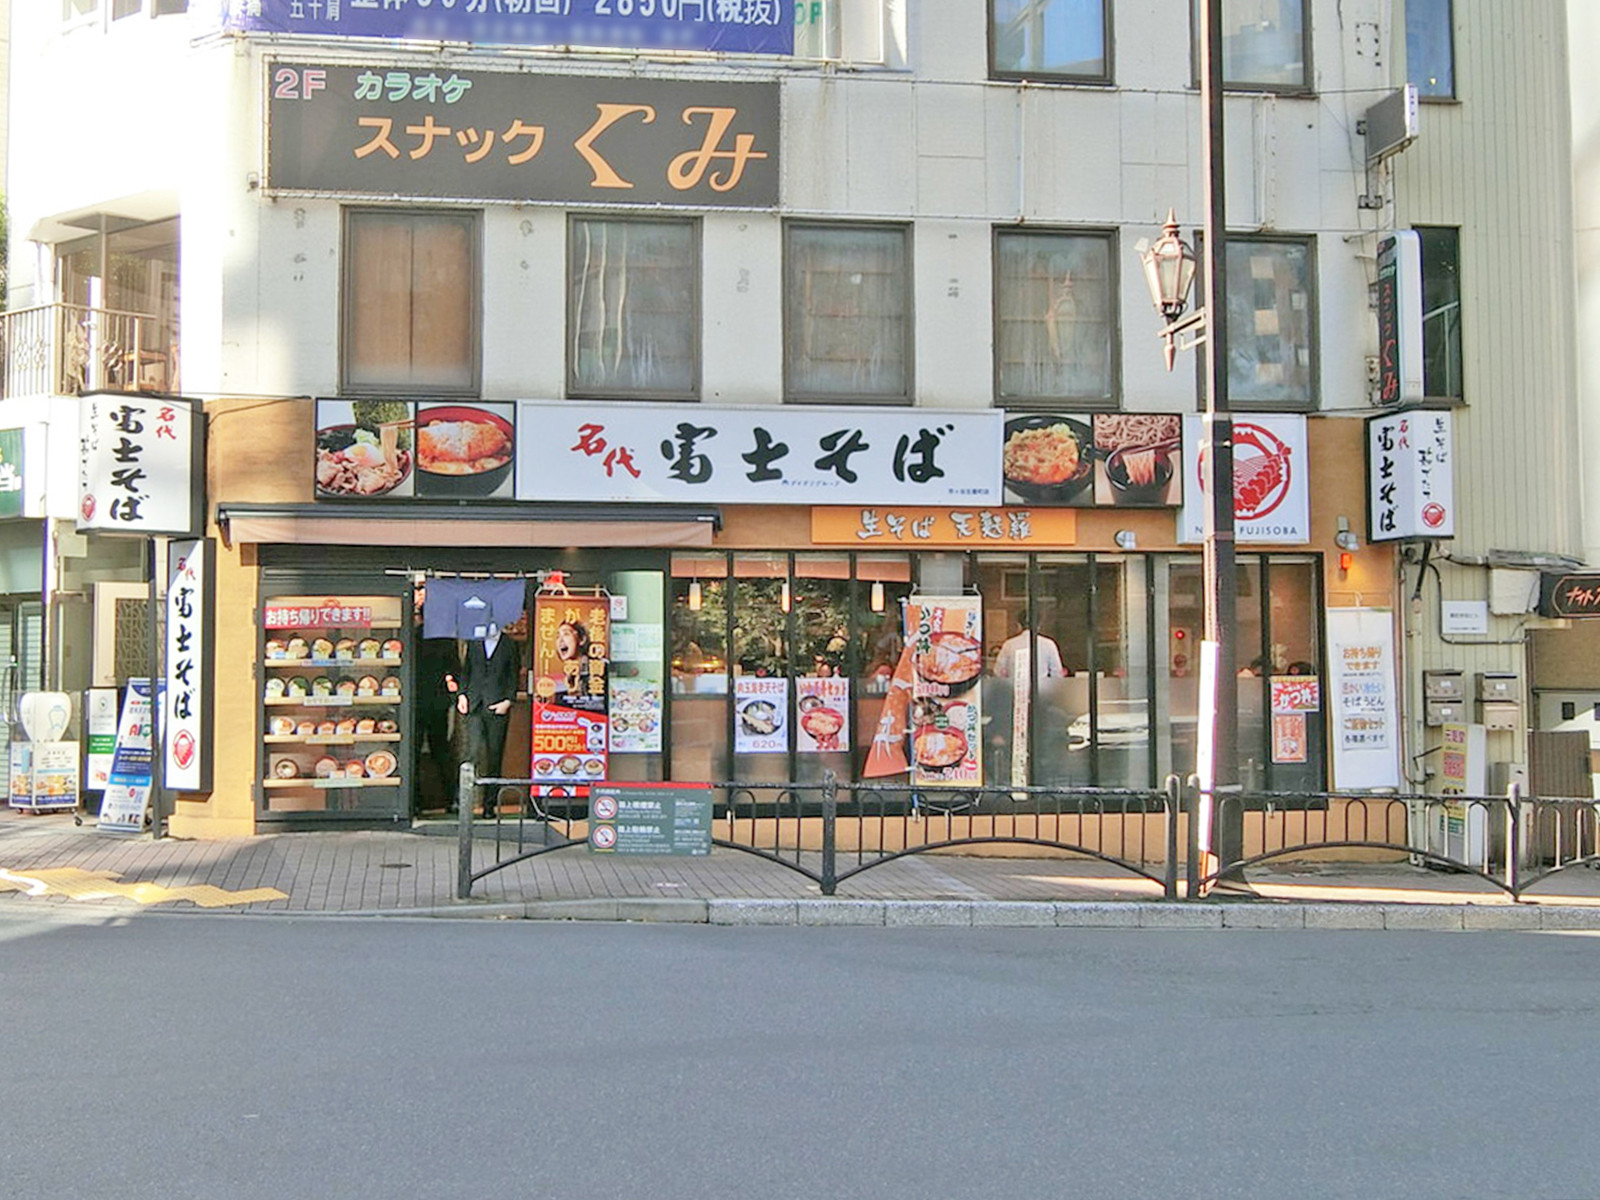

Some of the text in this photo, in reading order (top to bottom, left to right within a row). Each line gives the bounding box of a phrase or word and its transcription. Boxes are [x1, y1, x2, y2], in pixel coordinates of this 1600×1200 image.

[274, 68, 326, 99] 2F
[354, 70, 472, 104] カラオケ
[354, 115, 546, 166] スナック
[574, 103, 768, 191] くみ
[1382, 339, 1398, 400] くみ
[156, 407, 177, 440] 名代
[1398, 419, 1410, 450] 名代
[110, 405, 150, 522] 富士そば
[571, 422, 957, 484] 名代 富士そば
[1377, 425, 1399, 532] 富士そば
[856, 509, 936, 539] 生そば
[1240, 526, 1297, 535] FUJISOBA
[175, 587, 196, 720] 富士そば
[1364, 696, 1385, 706] うどん
